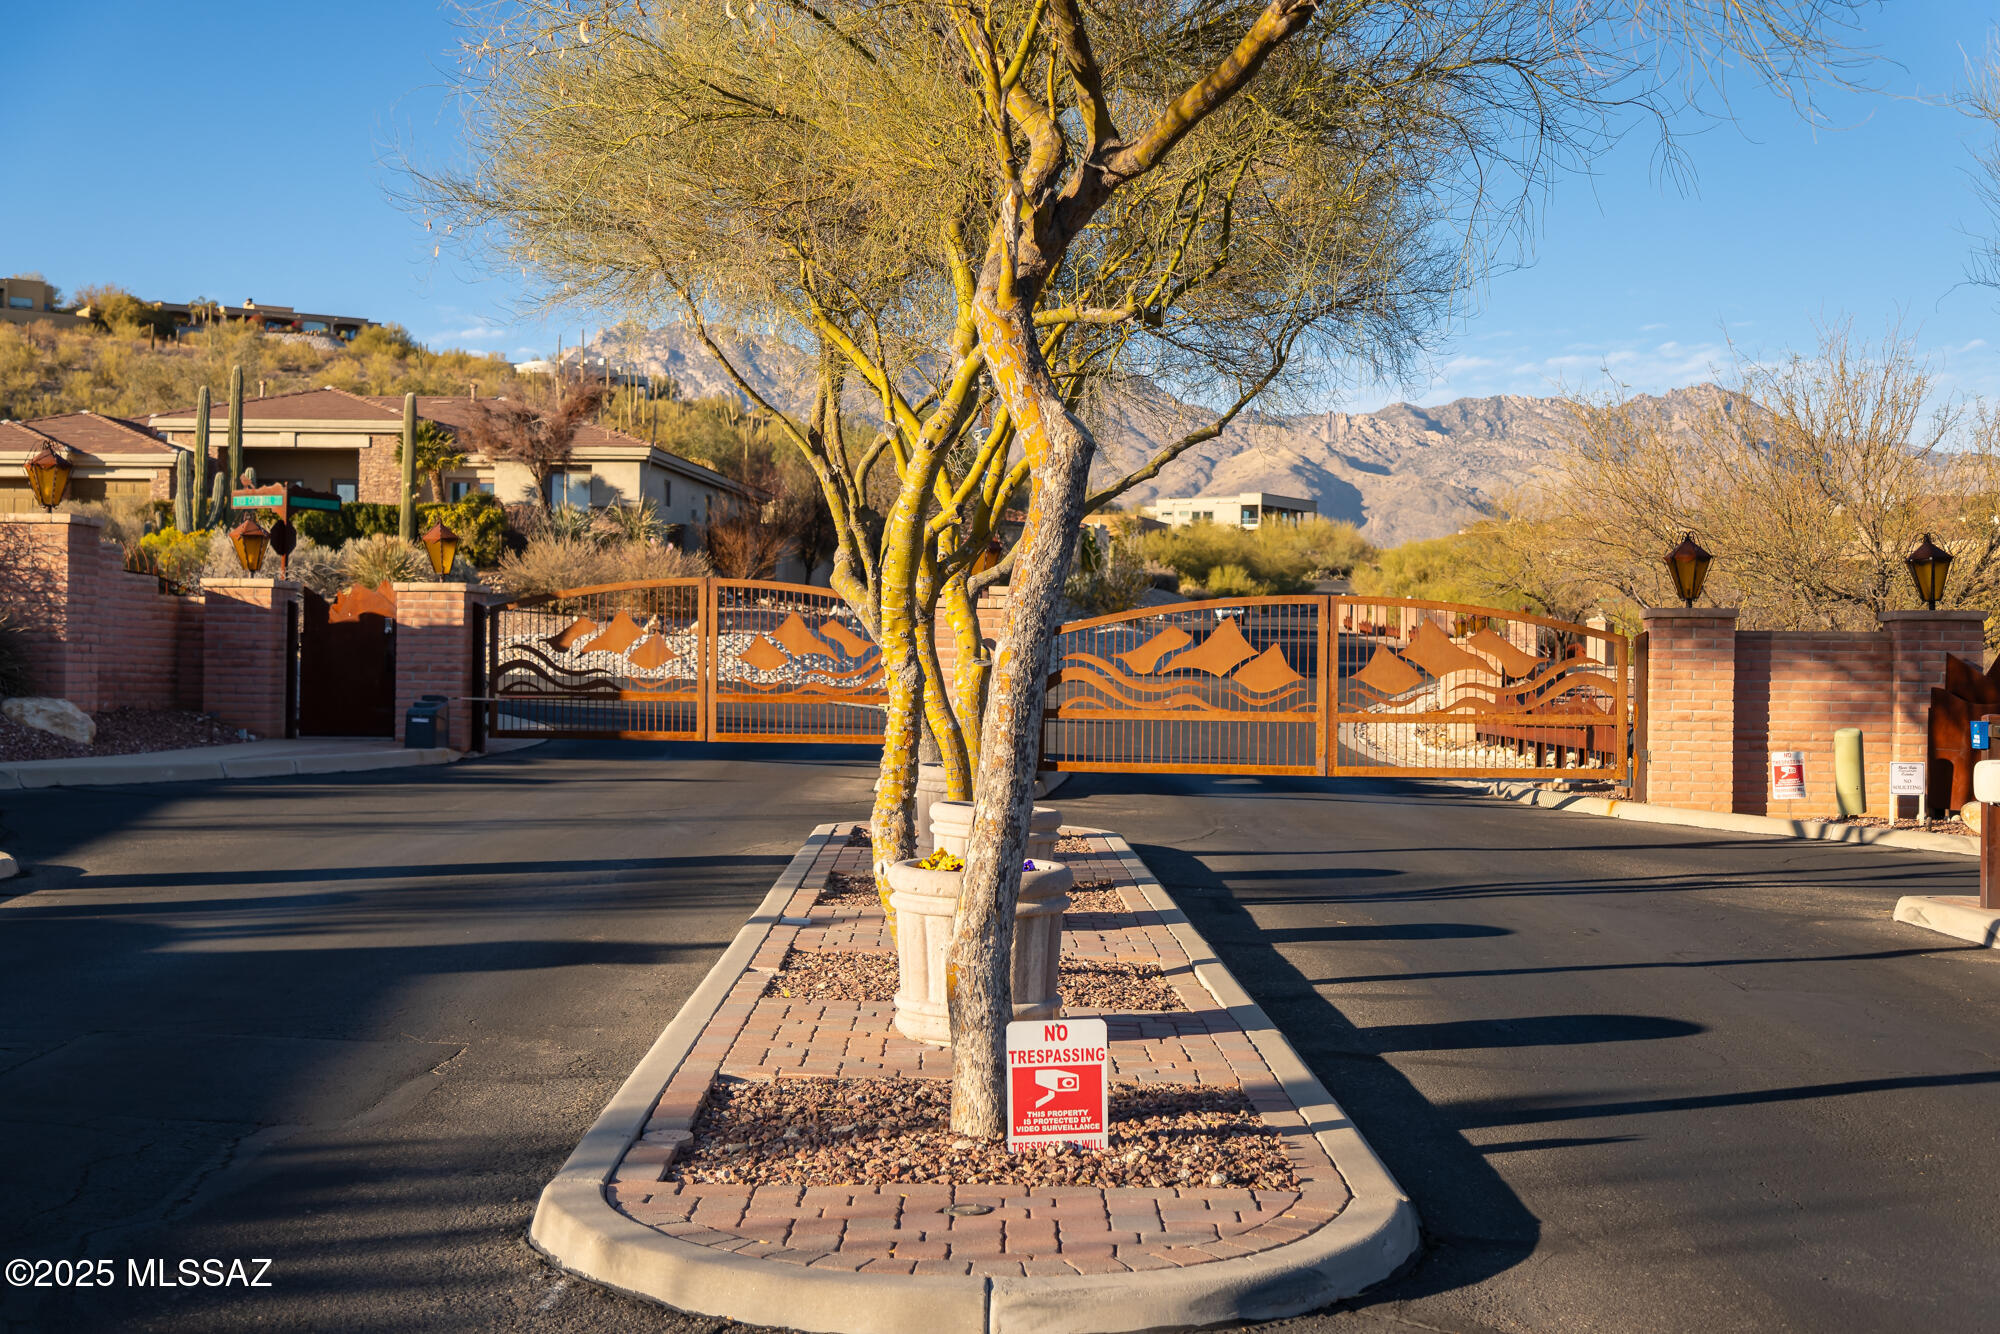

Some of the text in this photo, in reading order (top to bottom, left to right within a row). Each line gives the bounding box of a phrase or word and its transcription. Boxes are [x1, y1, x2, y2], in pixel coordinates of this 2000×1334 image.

[1044, 1024, 1068, 1042] NO
[1008, 1047, 1105, 1064] TRESPASSING
[1047, 1109, 1088, 1117] PROPERTY
[1033, 1117, 1079, 1125] PROTECTED
[1016, 1123, 1100, 1133] VIDEO SURVEILLANCE
[1081, 1138, 1105, 1151] WILL
